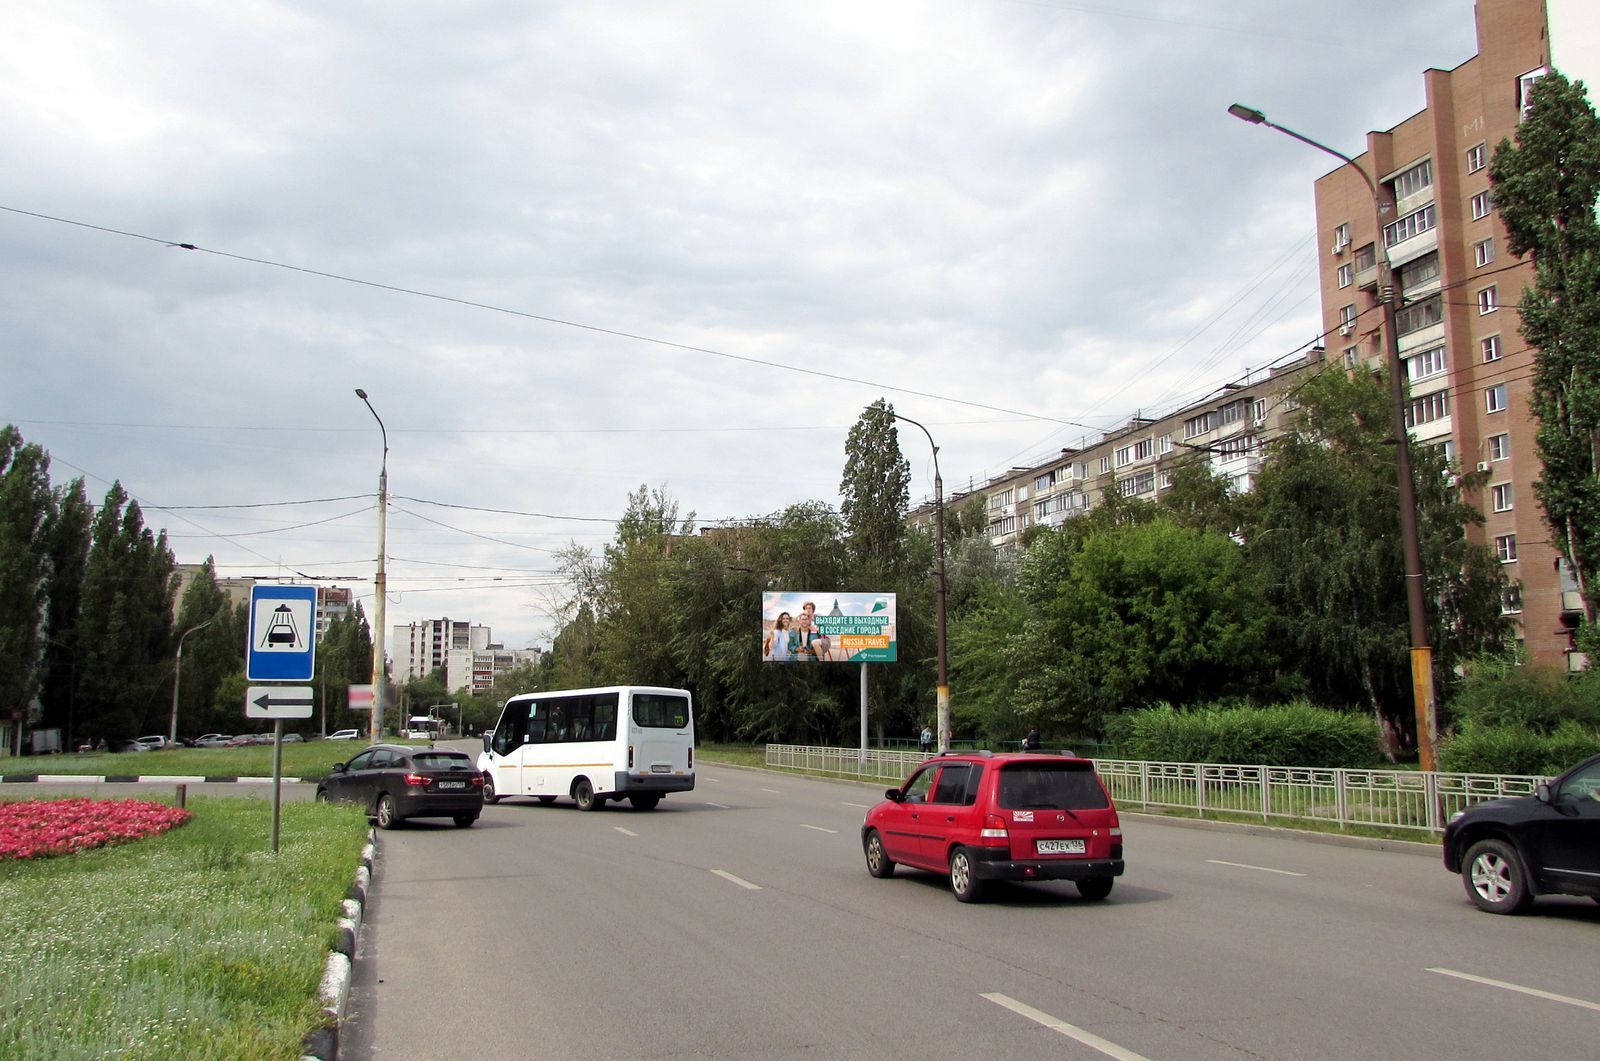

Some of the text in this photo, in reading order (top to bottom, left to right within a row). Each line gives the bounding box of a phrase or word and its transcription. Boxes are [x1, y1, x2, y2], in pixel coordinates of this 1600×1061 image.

[816, 617, 847, 625] ВЫХОДИТЕ
[854, 617, 888, 625] ВЫХОДНЫЕ
[826, 626, 856, 635] СОСЕДНИЕ
[857, 626, 880, 635] ГОРОДА
